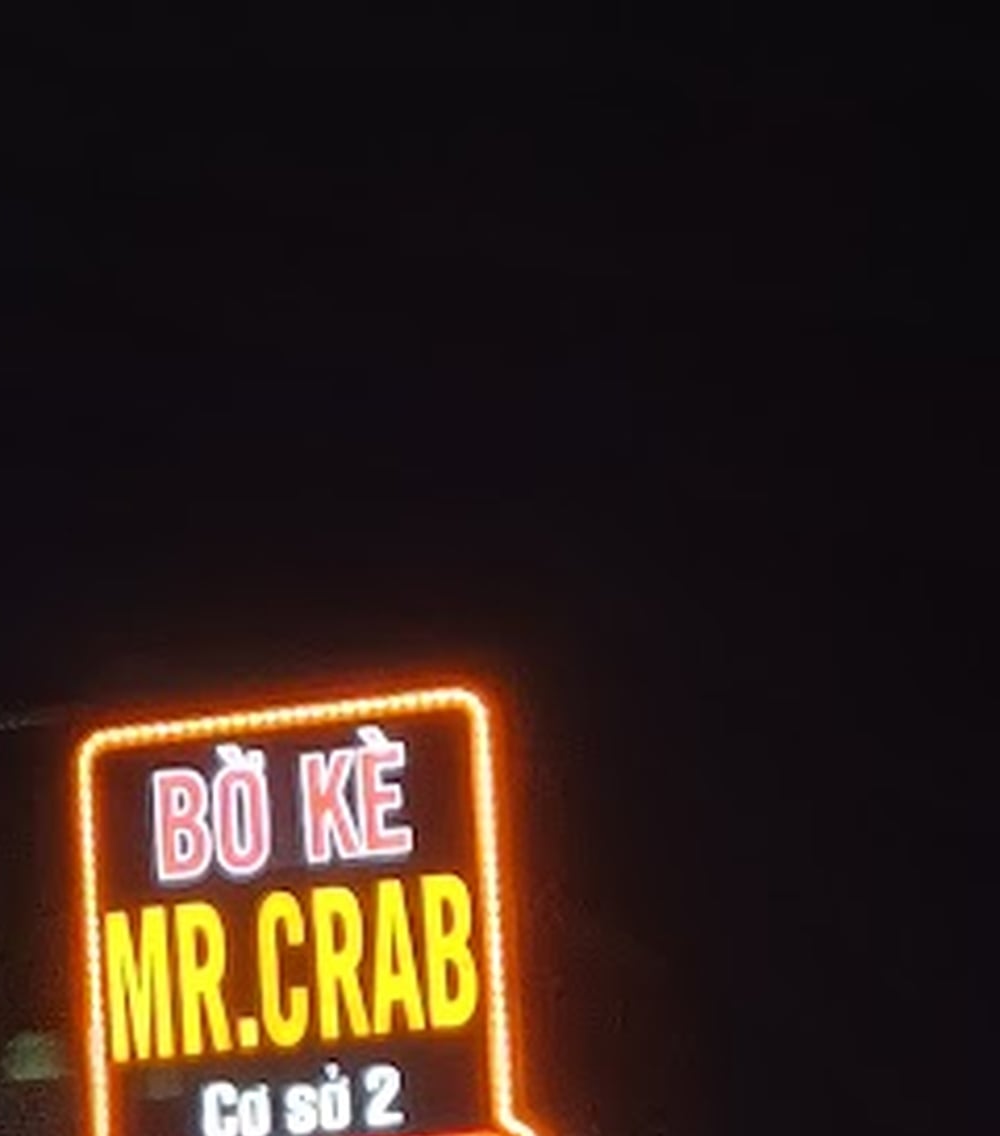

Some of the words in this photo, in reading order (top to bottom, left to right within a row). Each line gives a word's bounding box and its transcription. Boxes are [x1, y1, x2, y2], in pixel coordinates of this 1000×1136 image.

[153, 743, 272, 882] BỜ
[299, 724, 414, 865] KÈ
[104, 874, 479, 1063] MR.CRAB
[284, 1062, 351, 1135] sở
[363, 1064, 405, 1128] 2
